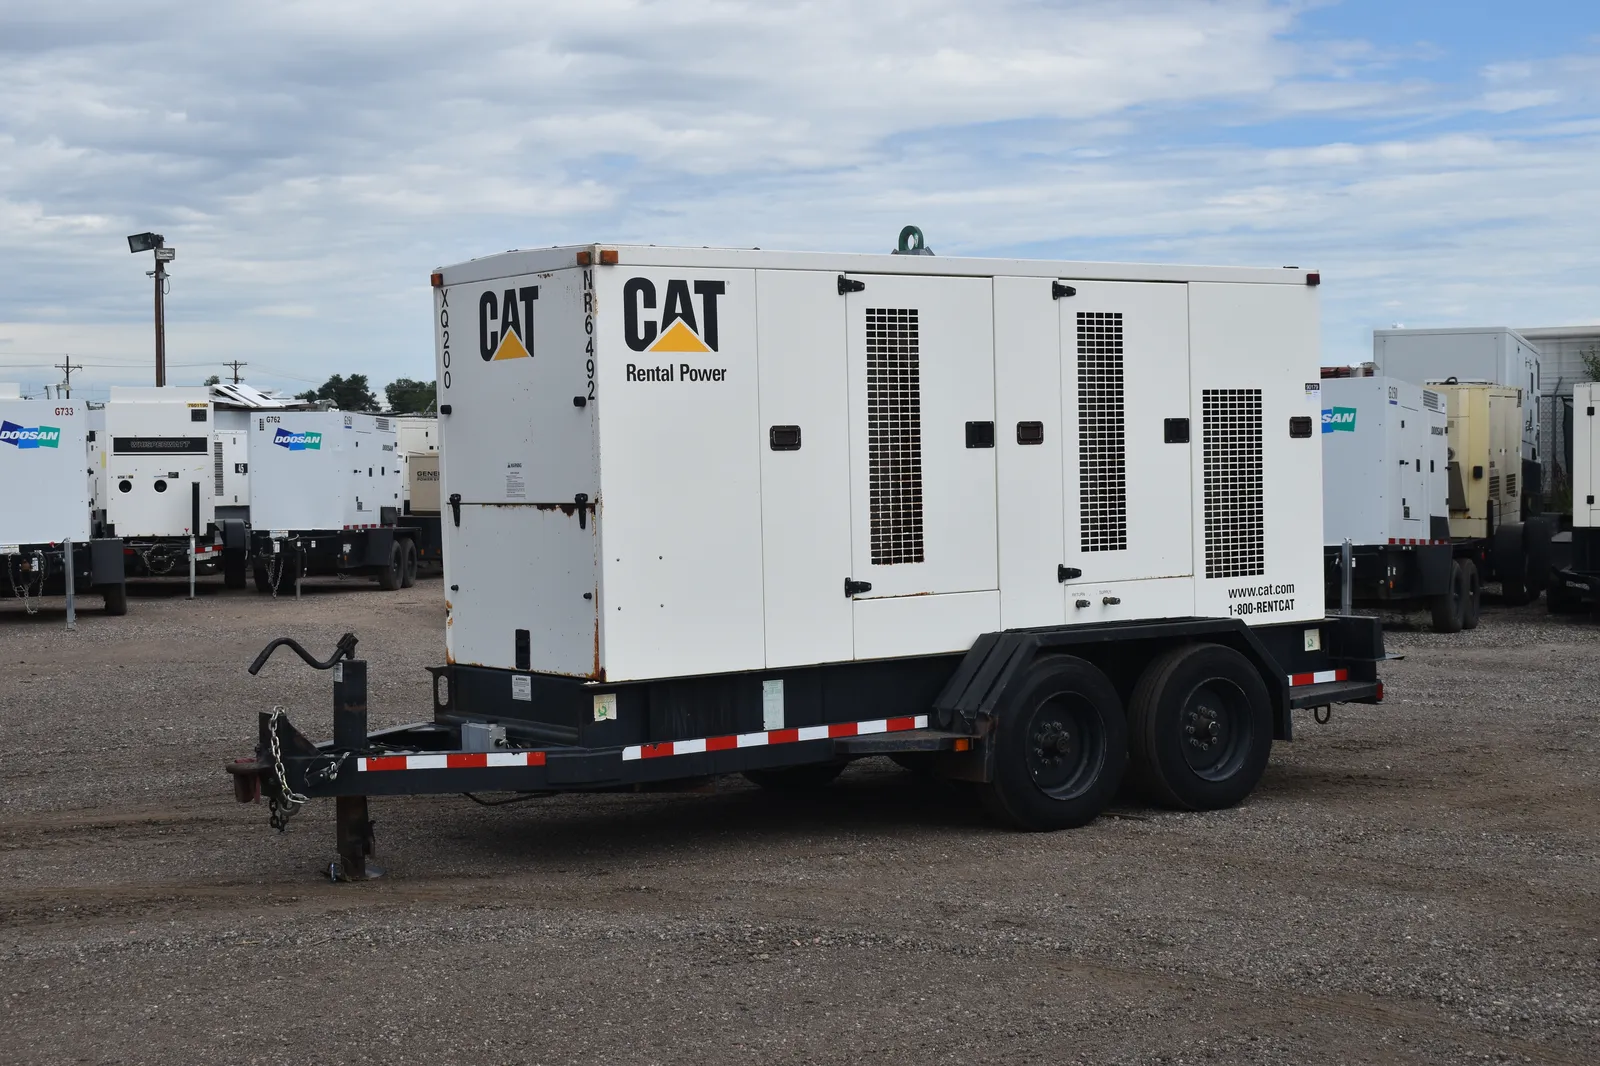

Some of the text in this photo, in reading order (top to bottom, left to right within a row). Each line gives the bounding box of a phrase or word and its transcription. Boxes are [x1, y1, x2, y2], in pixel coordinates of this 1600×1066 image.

[623, 276, 726, 352] CAT
[479, 285, 539, 362] CAT
[440, 289, 452, 389] XQ200
[583, 269, 595, 401] NR6492
[626, 363, 727, 382] Rental Power
[54, 407, 74, 416] G733
[266, 416, 281, 424] G762
[0, 430, 59, 441] DOOSAN
[274, 434, 321, 444] DOOSAN
[1228, 583, 1295, 599] www.cat.com
[1228, 598, 1295, 616] 1-800-RENTCAT
